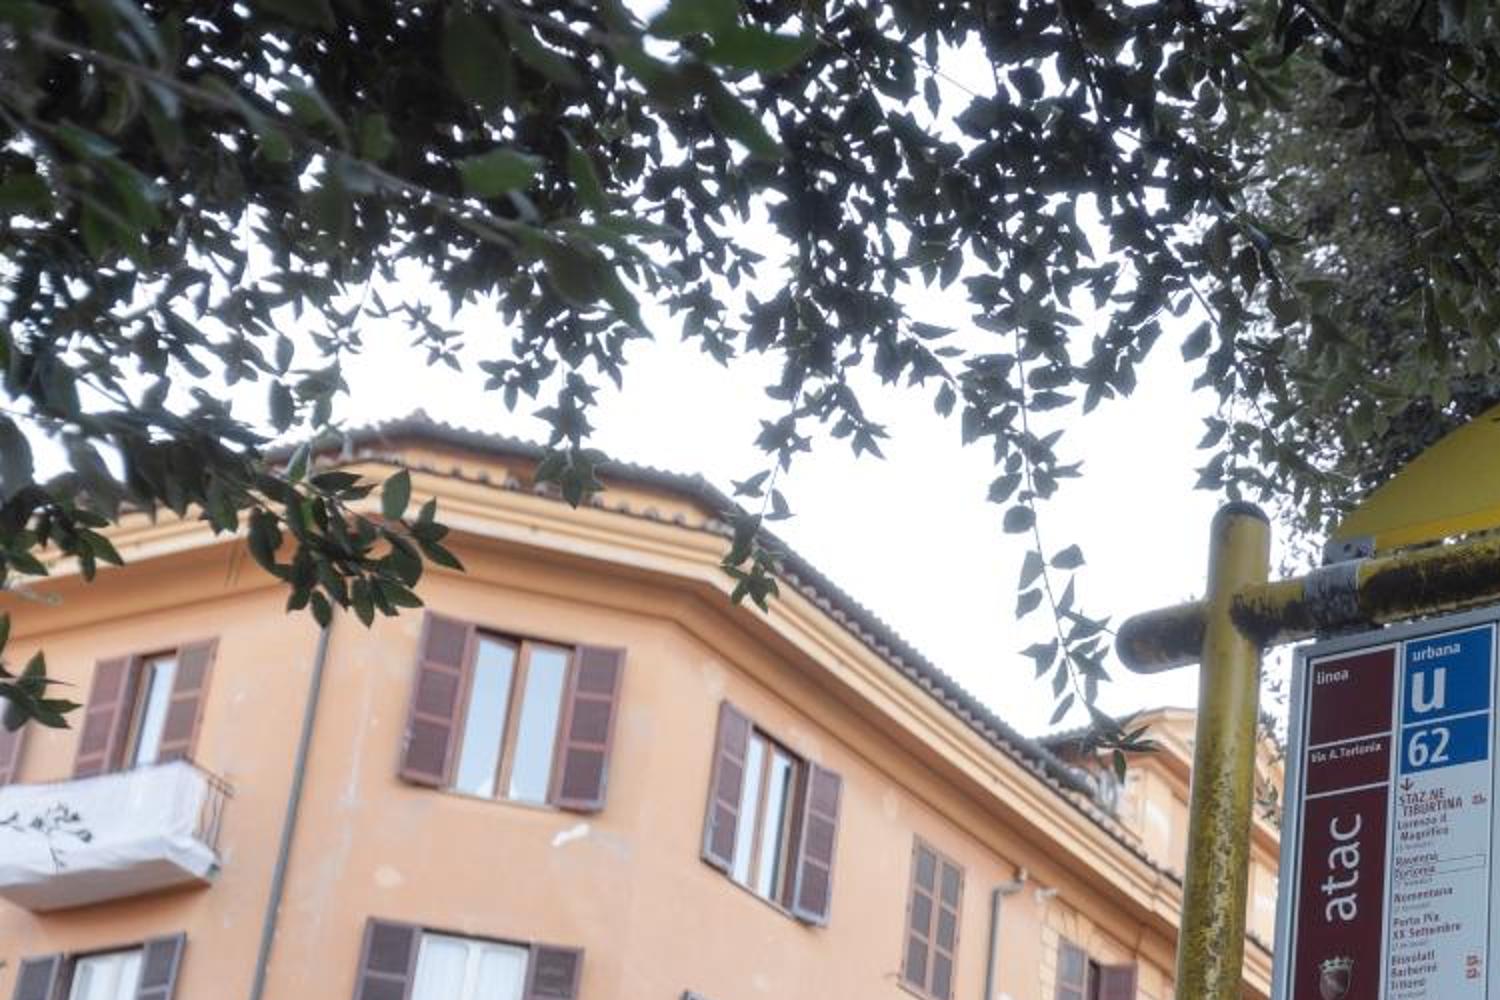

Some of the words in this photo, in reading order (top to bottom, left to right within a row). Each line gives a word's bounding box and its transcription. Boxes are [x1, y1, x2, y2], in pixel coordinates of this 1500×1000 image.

[1412, 642, 1461, 662] urbana
[1317, 669, 1349, 685] linea
[1408, 727, 1451, 767] 62
[1403, 796, 1463, 816] TIBURTINA
[1320, 813, 1363, 922] atac
